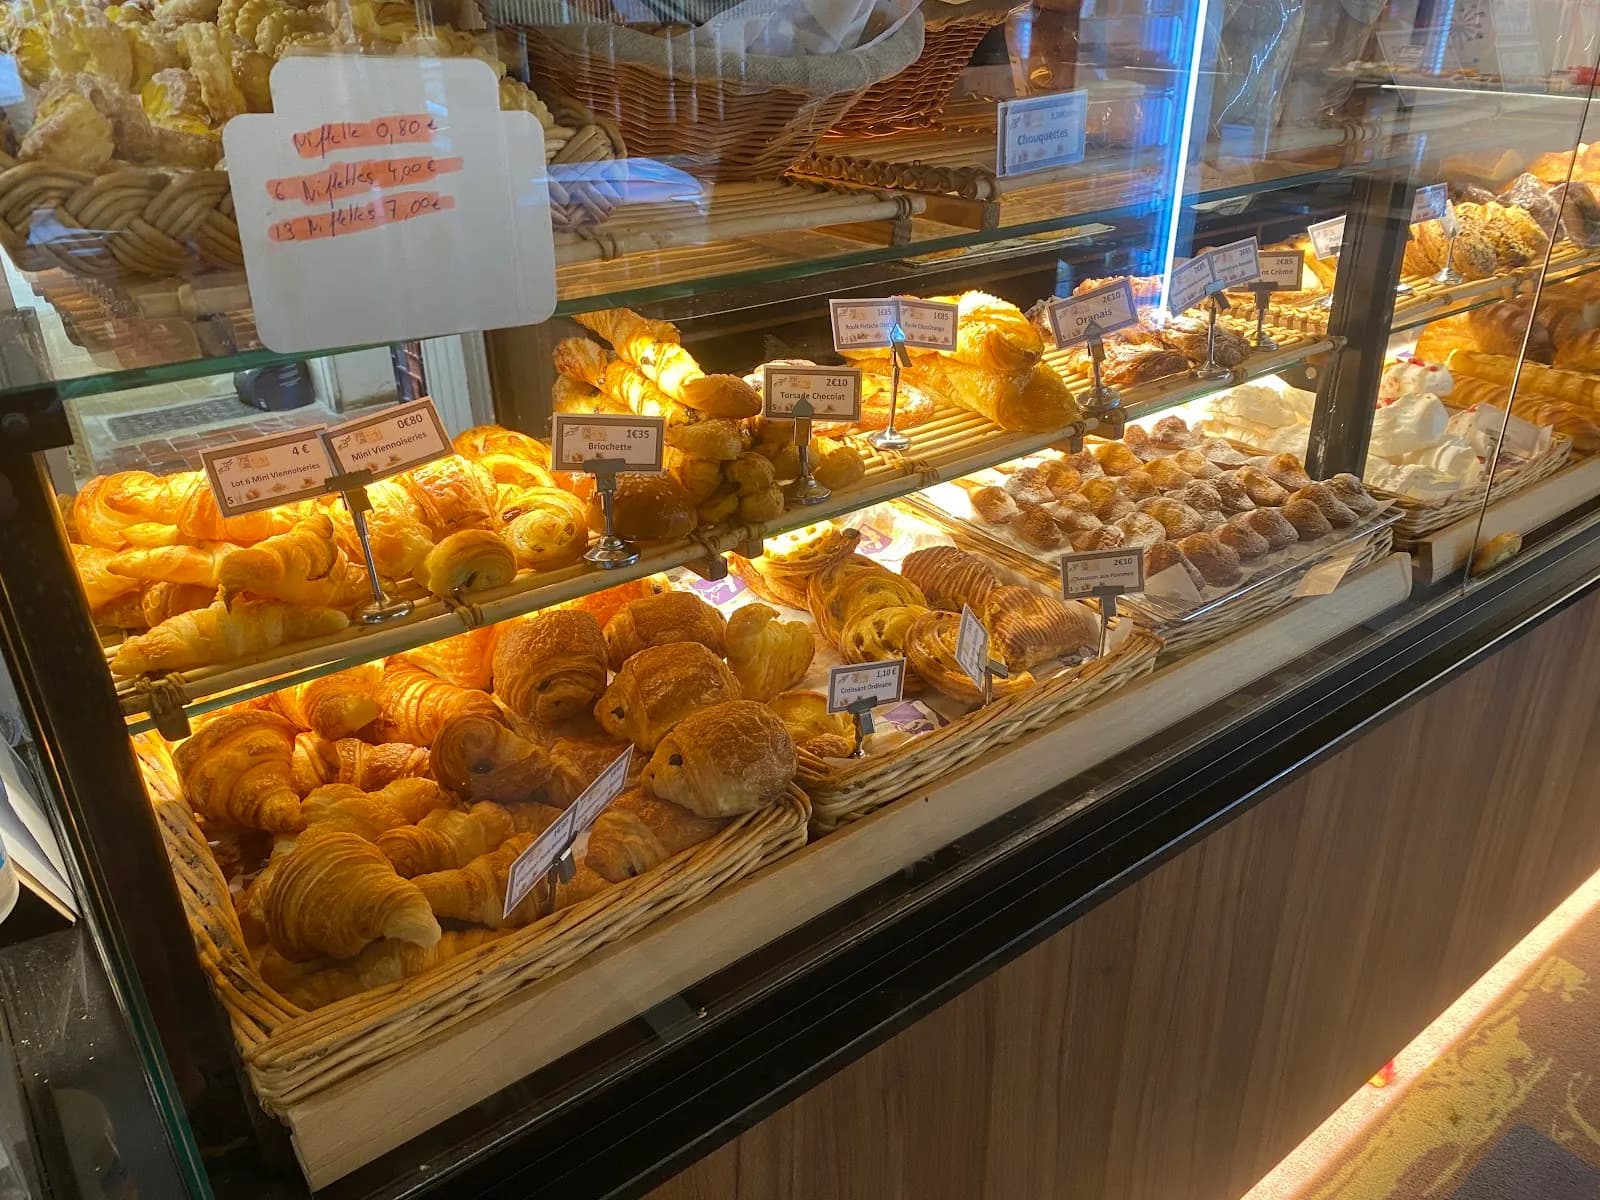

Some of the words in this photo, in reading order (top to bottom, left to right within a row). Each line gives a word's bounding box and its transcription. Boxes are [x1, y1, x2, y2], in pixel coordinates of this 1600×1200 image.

[1017, 128, 1069, 145] Chouquettes
[275, 182, 285, 201] 6
[274, 225, 296, 241] 13
[1075, 308, 1113, 326] Oranais
[825, 378, 848, 387] 2€10
[780, 391, 810, 400] Torsade
[812, 392, 845, 401] Chocolat
[397, 413, 424, 430] 0€80
[626, 429, 650, 439] 1€35
[291, 446, 299, 456] 4
[302, 444, 311, 454] €
[351, 449, 372, 463] Mini
[372, 431, 428, 455] Viennoiseries
[588, 442, 632, 451] Briochette
[230, 478, 245, 488] Lot
[251, 472, 271, 484] Mini
[271, 462, 320, 480] Viennoiseries
[1113, 557, 1133, 566] 2€10
[840, 686, 866, 694] Croissant
[867, 681, 892, 690] Ordinaire
